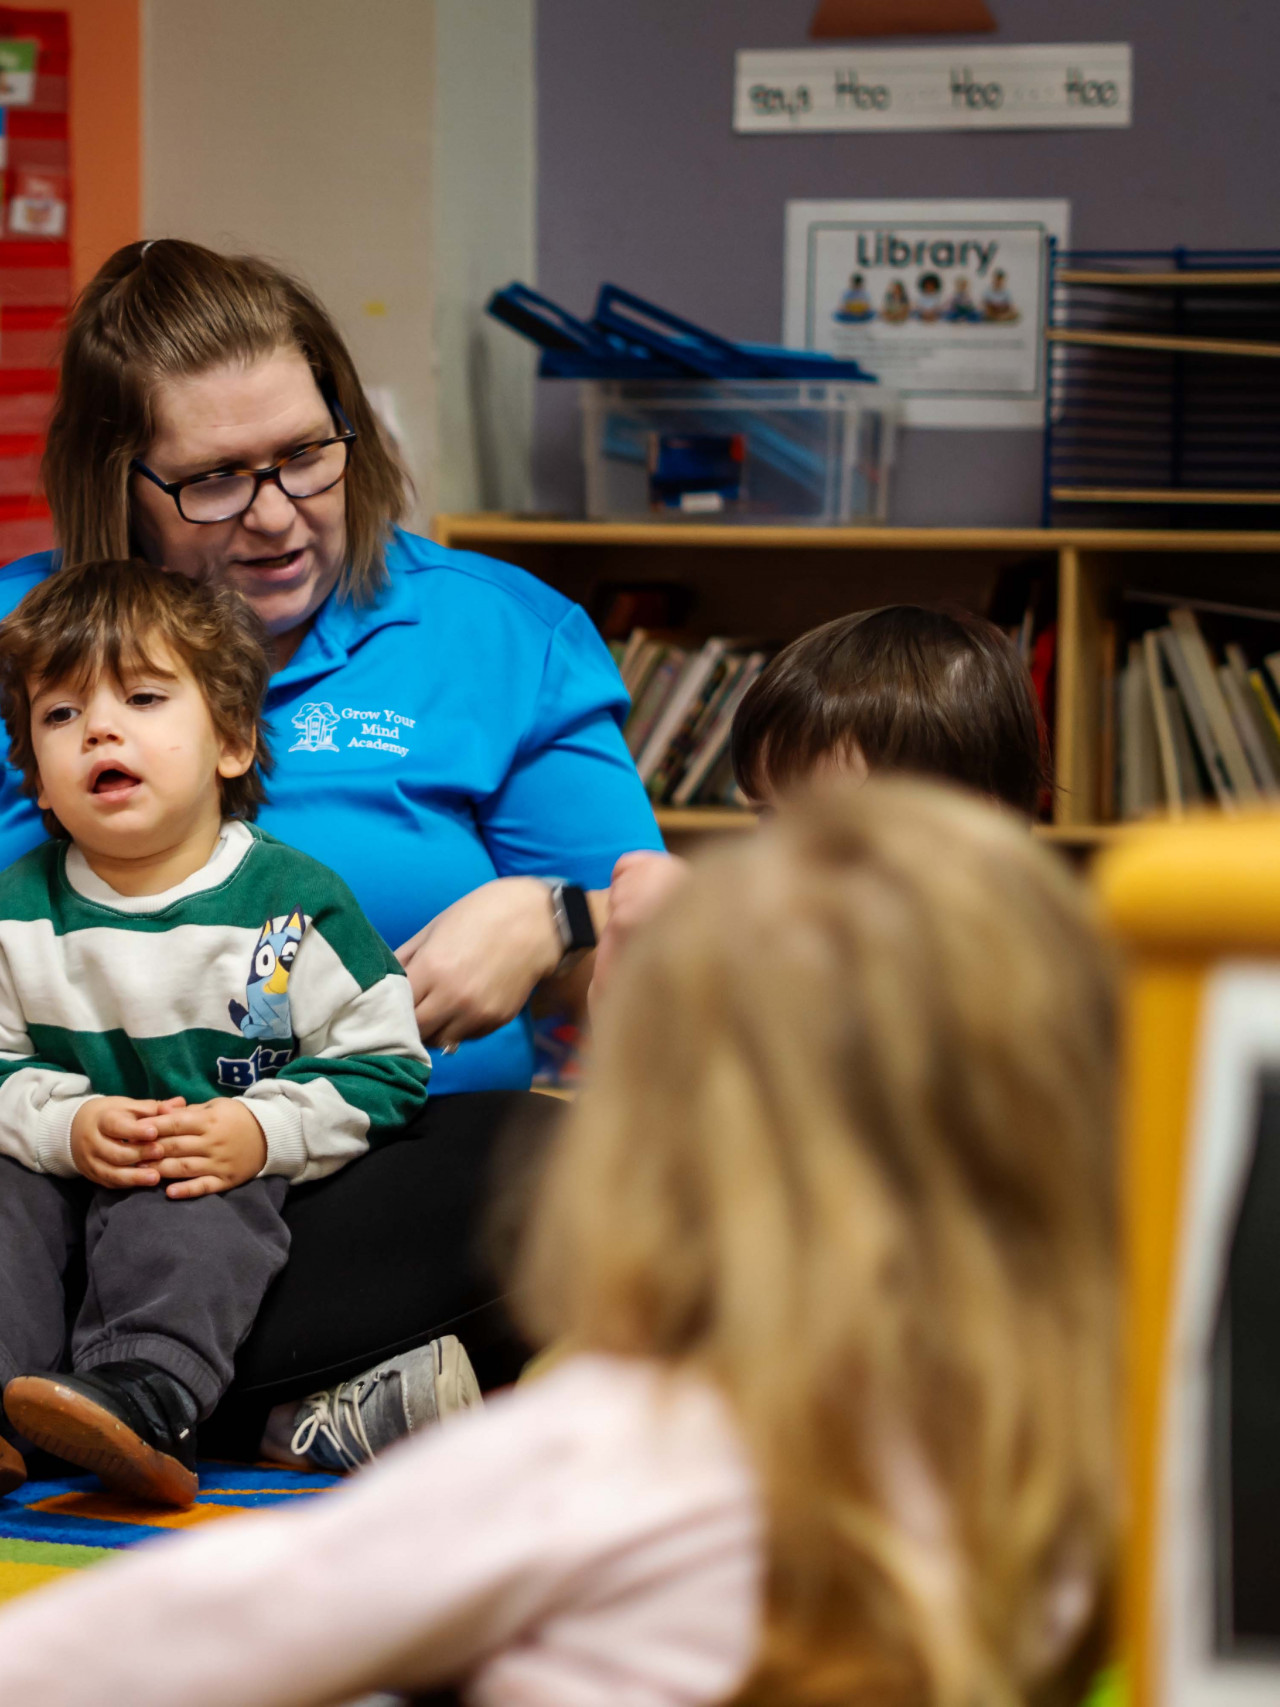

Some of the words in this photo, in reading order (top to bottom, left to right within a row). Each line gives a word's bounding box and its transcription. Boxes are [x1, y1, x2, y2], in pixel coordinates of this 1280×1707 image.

[833, 65, 891, 111] Hoo
[950, 64, 1004, 110] Hoo
[1066, 64, 1119, 108] Hoo
[856, 231, 997, 277] Library
[341, 708, 381, 720] Grow
[383, 709, 416, 728] Your
[361, 723, 399, 739] Mind
[347, 737, 410, 757] Academy
[217, 1045, 293, 1088] Blu
